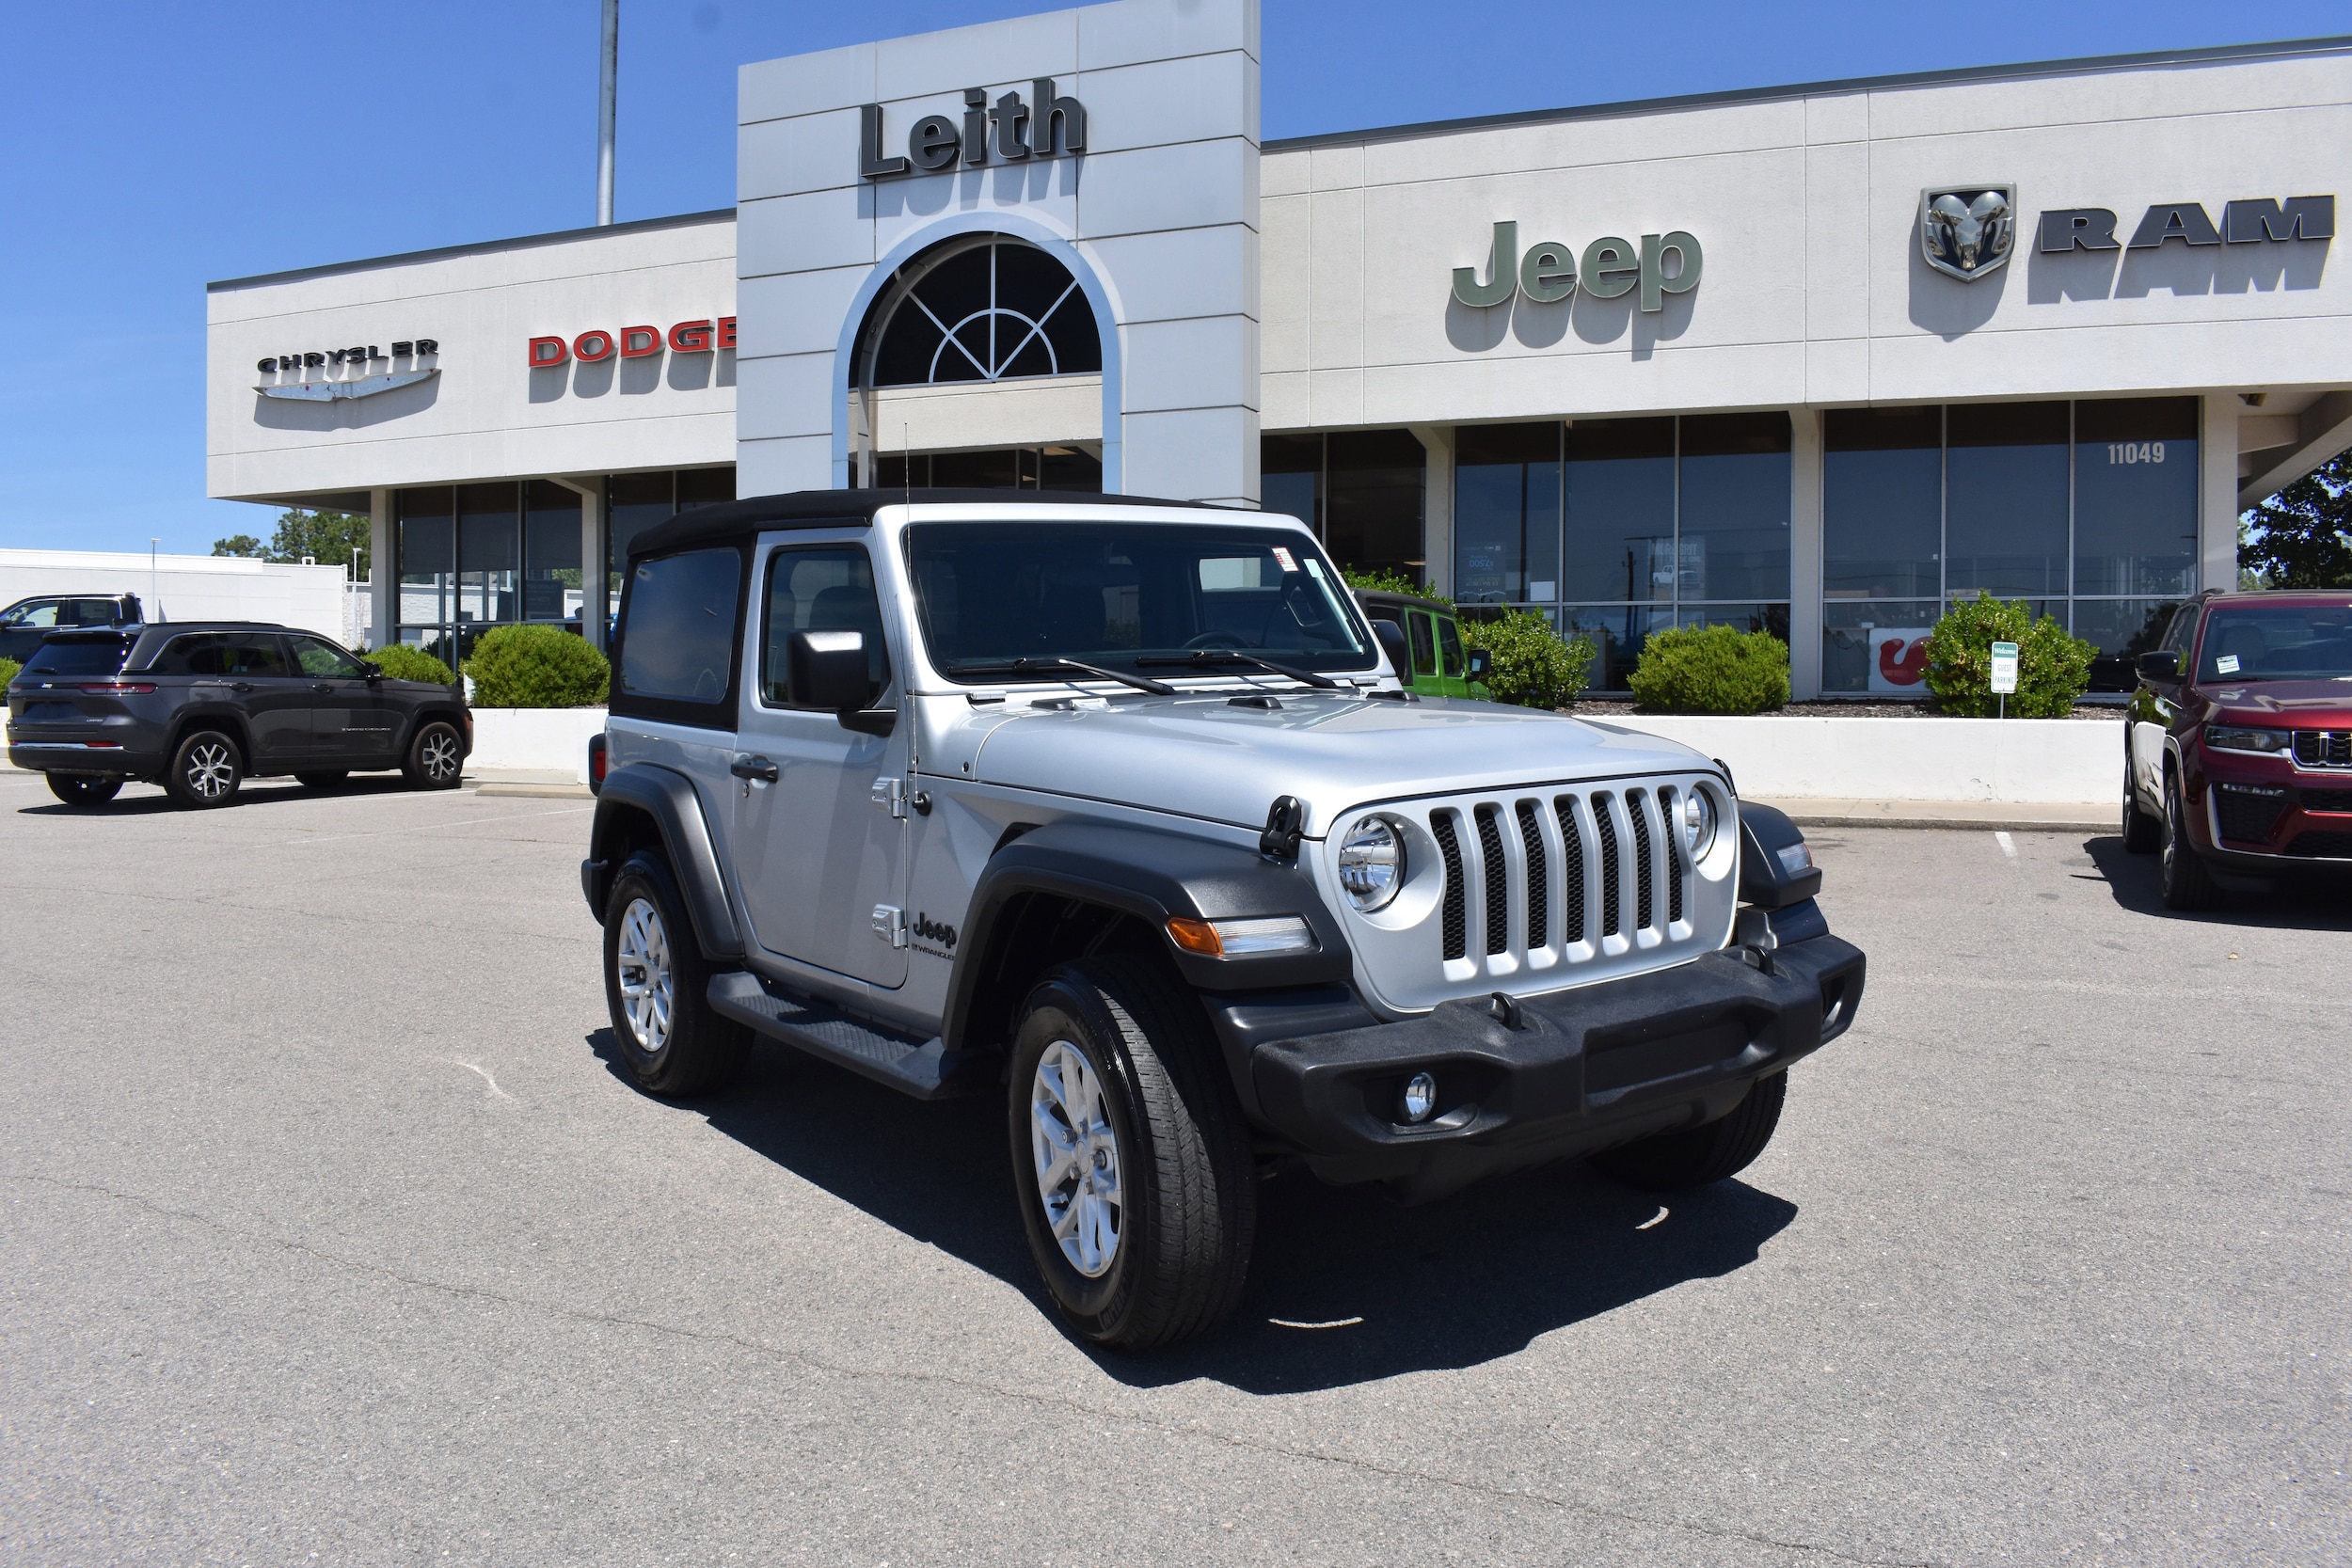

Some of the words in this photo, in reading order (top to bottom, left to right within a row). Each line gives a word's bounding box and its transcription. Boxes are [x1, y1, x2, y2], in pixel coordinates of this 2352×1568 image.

[860, 78, 1087, 178] Leith
[2040, 195, 2335, 253] RAM
[1453, 220, 1703, 312] Jeep
[257, 339, 438, 373] CHRYSLER
[2107, 442, 2165, 465] 11049
[1994, 675, 2014, 685] PARKING
[1997, 664, 2011, 673] GUEST
[913, 911, 957, 949] Jeep
